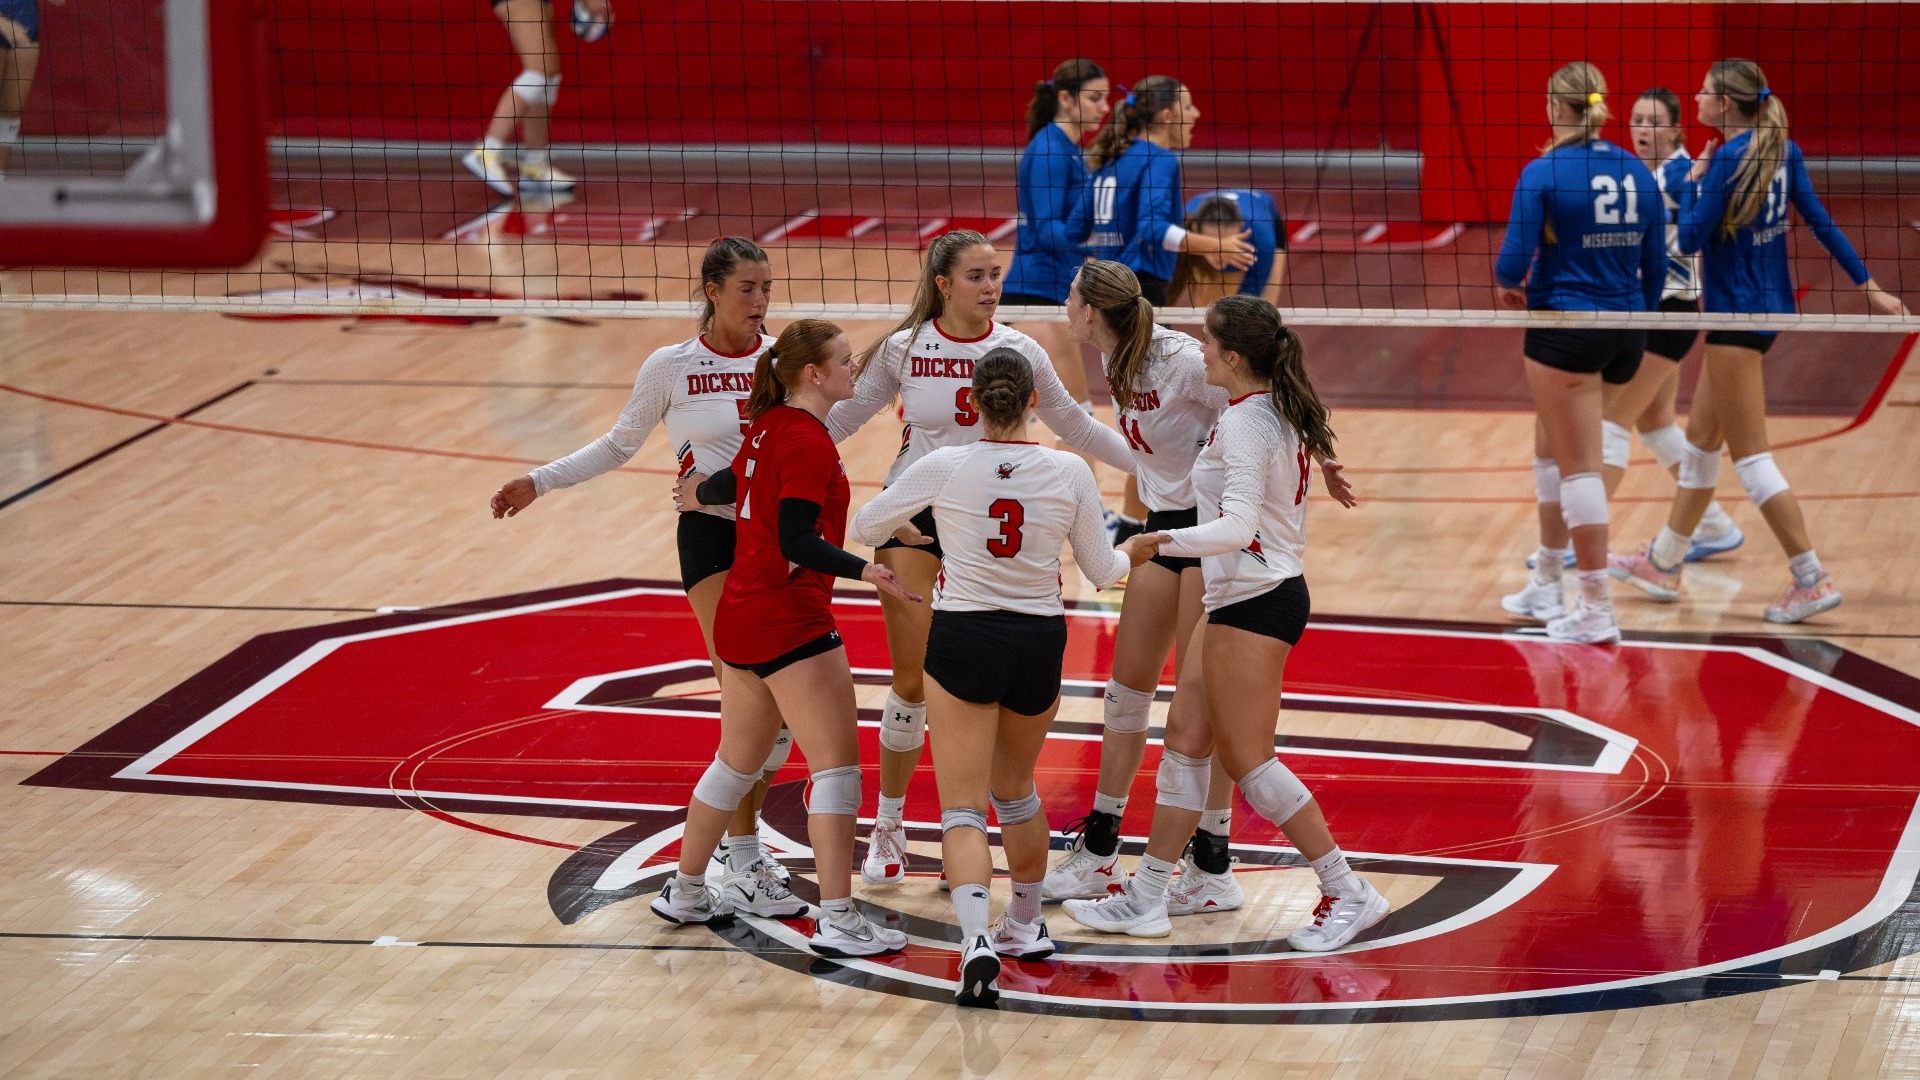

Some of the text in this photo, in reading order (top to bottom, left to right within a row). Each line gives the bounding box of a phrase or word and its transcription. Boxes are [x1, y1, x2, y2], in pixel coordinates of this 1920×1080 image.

[1093, 175, 1117, 225] 10
[1591, 173, 1639, 225] 21
[687, 372, 754, 396] DICKIN
[986, 498, 1024, 558] 3
